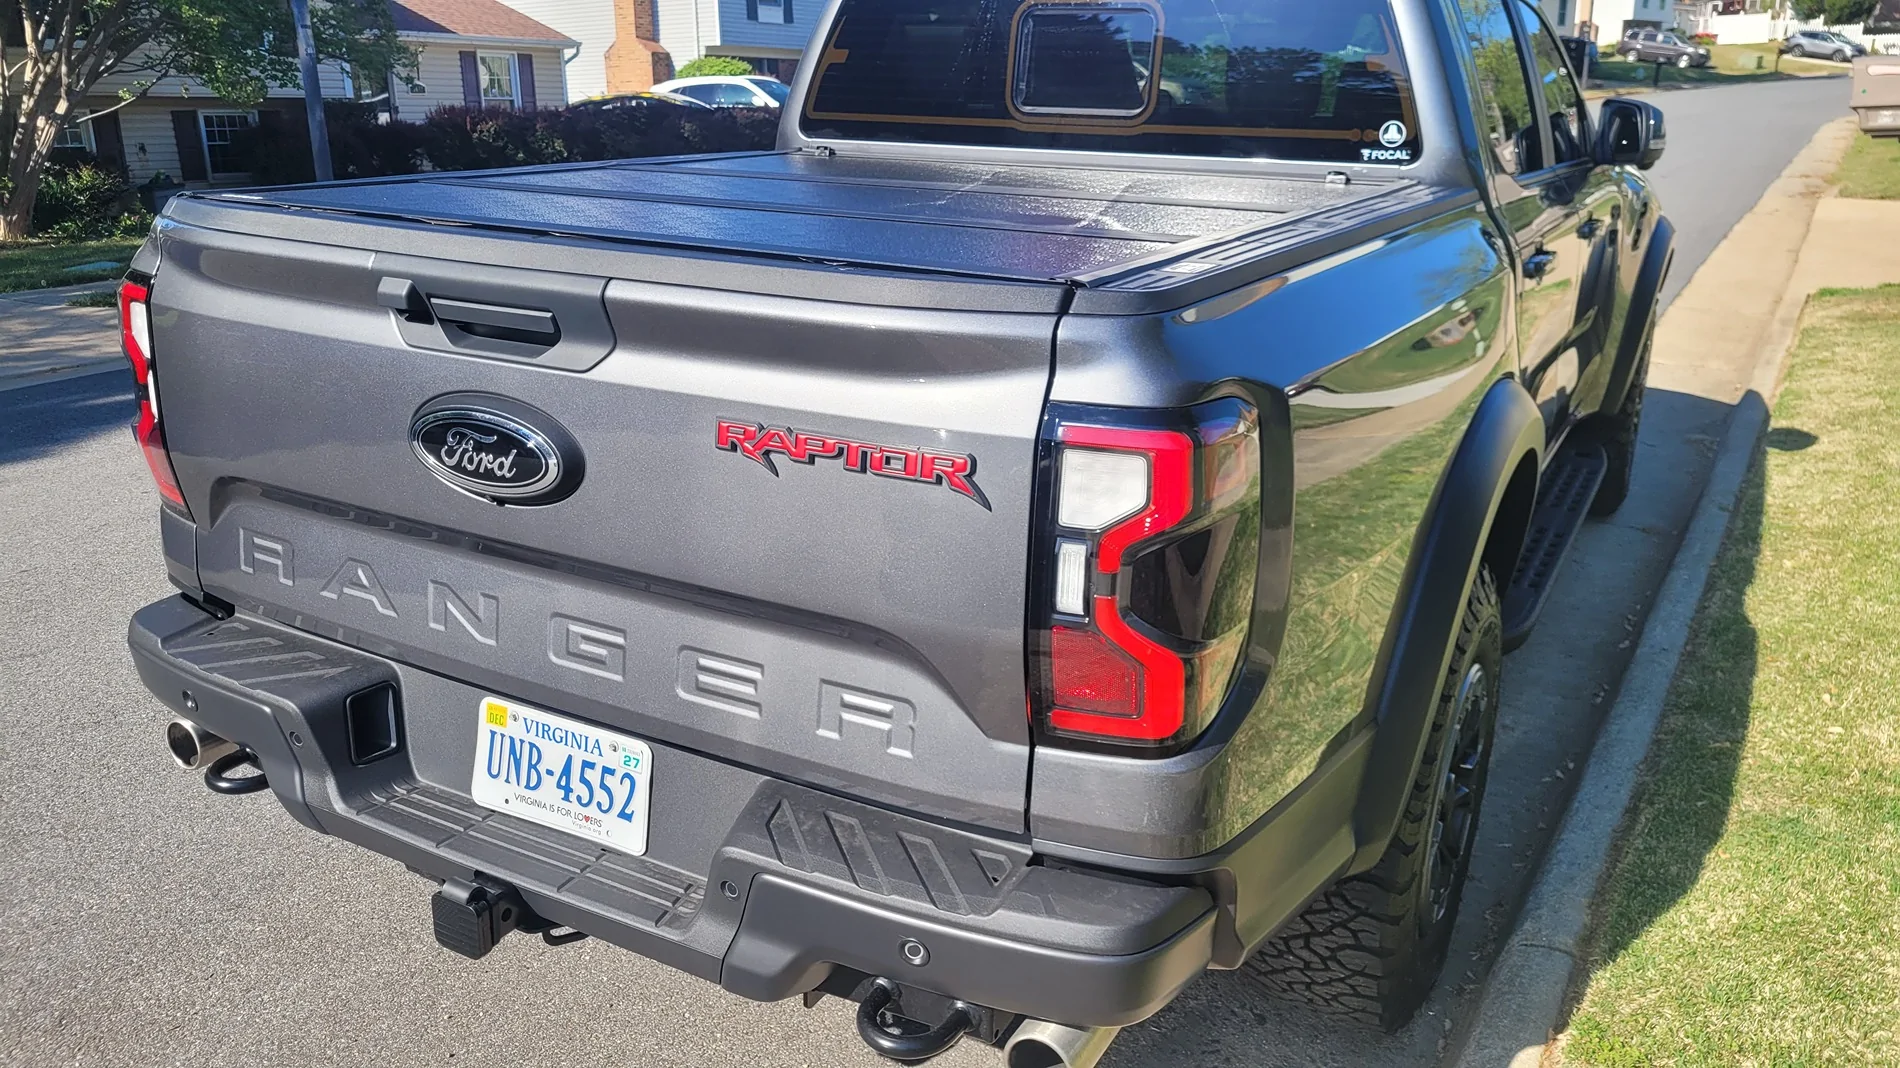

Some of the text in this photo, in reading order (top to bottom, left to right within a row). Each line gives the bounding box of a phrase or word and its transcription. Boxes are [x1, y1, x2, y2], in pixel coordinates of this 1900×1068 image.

[1371, 149, 1410, 160] FOCAL
[440, 427, 517, 478] Ford
[715, 416, 992, 513] RAPTOR
[238, 526, 917, 760] RANGER
[489, 712, 505, 726] DEC
[522, 716, 603, 757] VIRGINIA
[487, 729, 637, 823] UNB-4552
[623, 754, 640, 769] 27
[513, 792, 547, 811] VIRGINIA
[549, 804, 556, 813] IS
[556, 806, 573, 819] FOR
